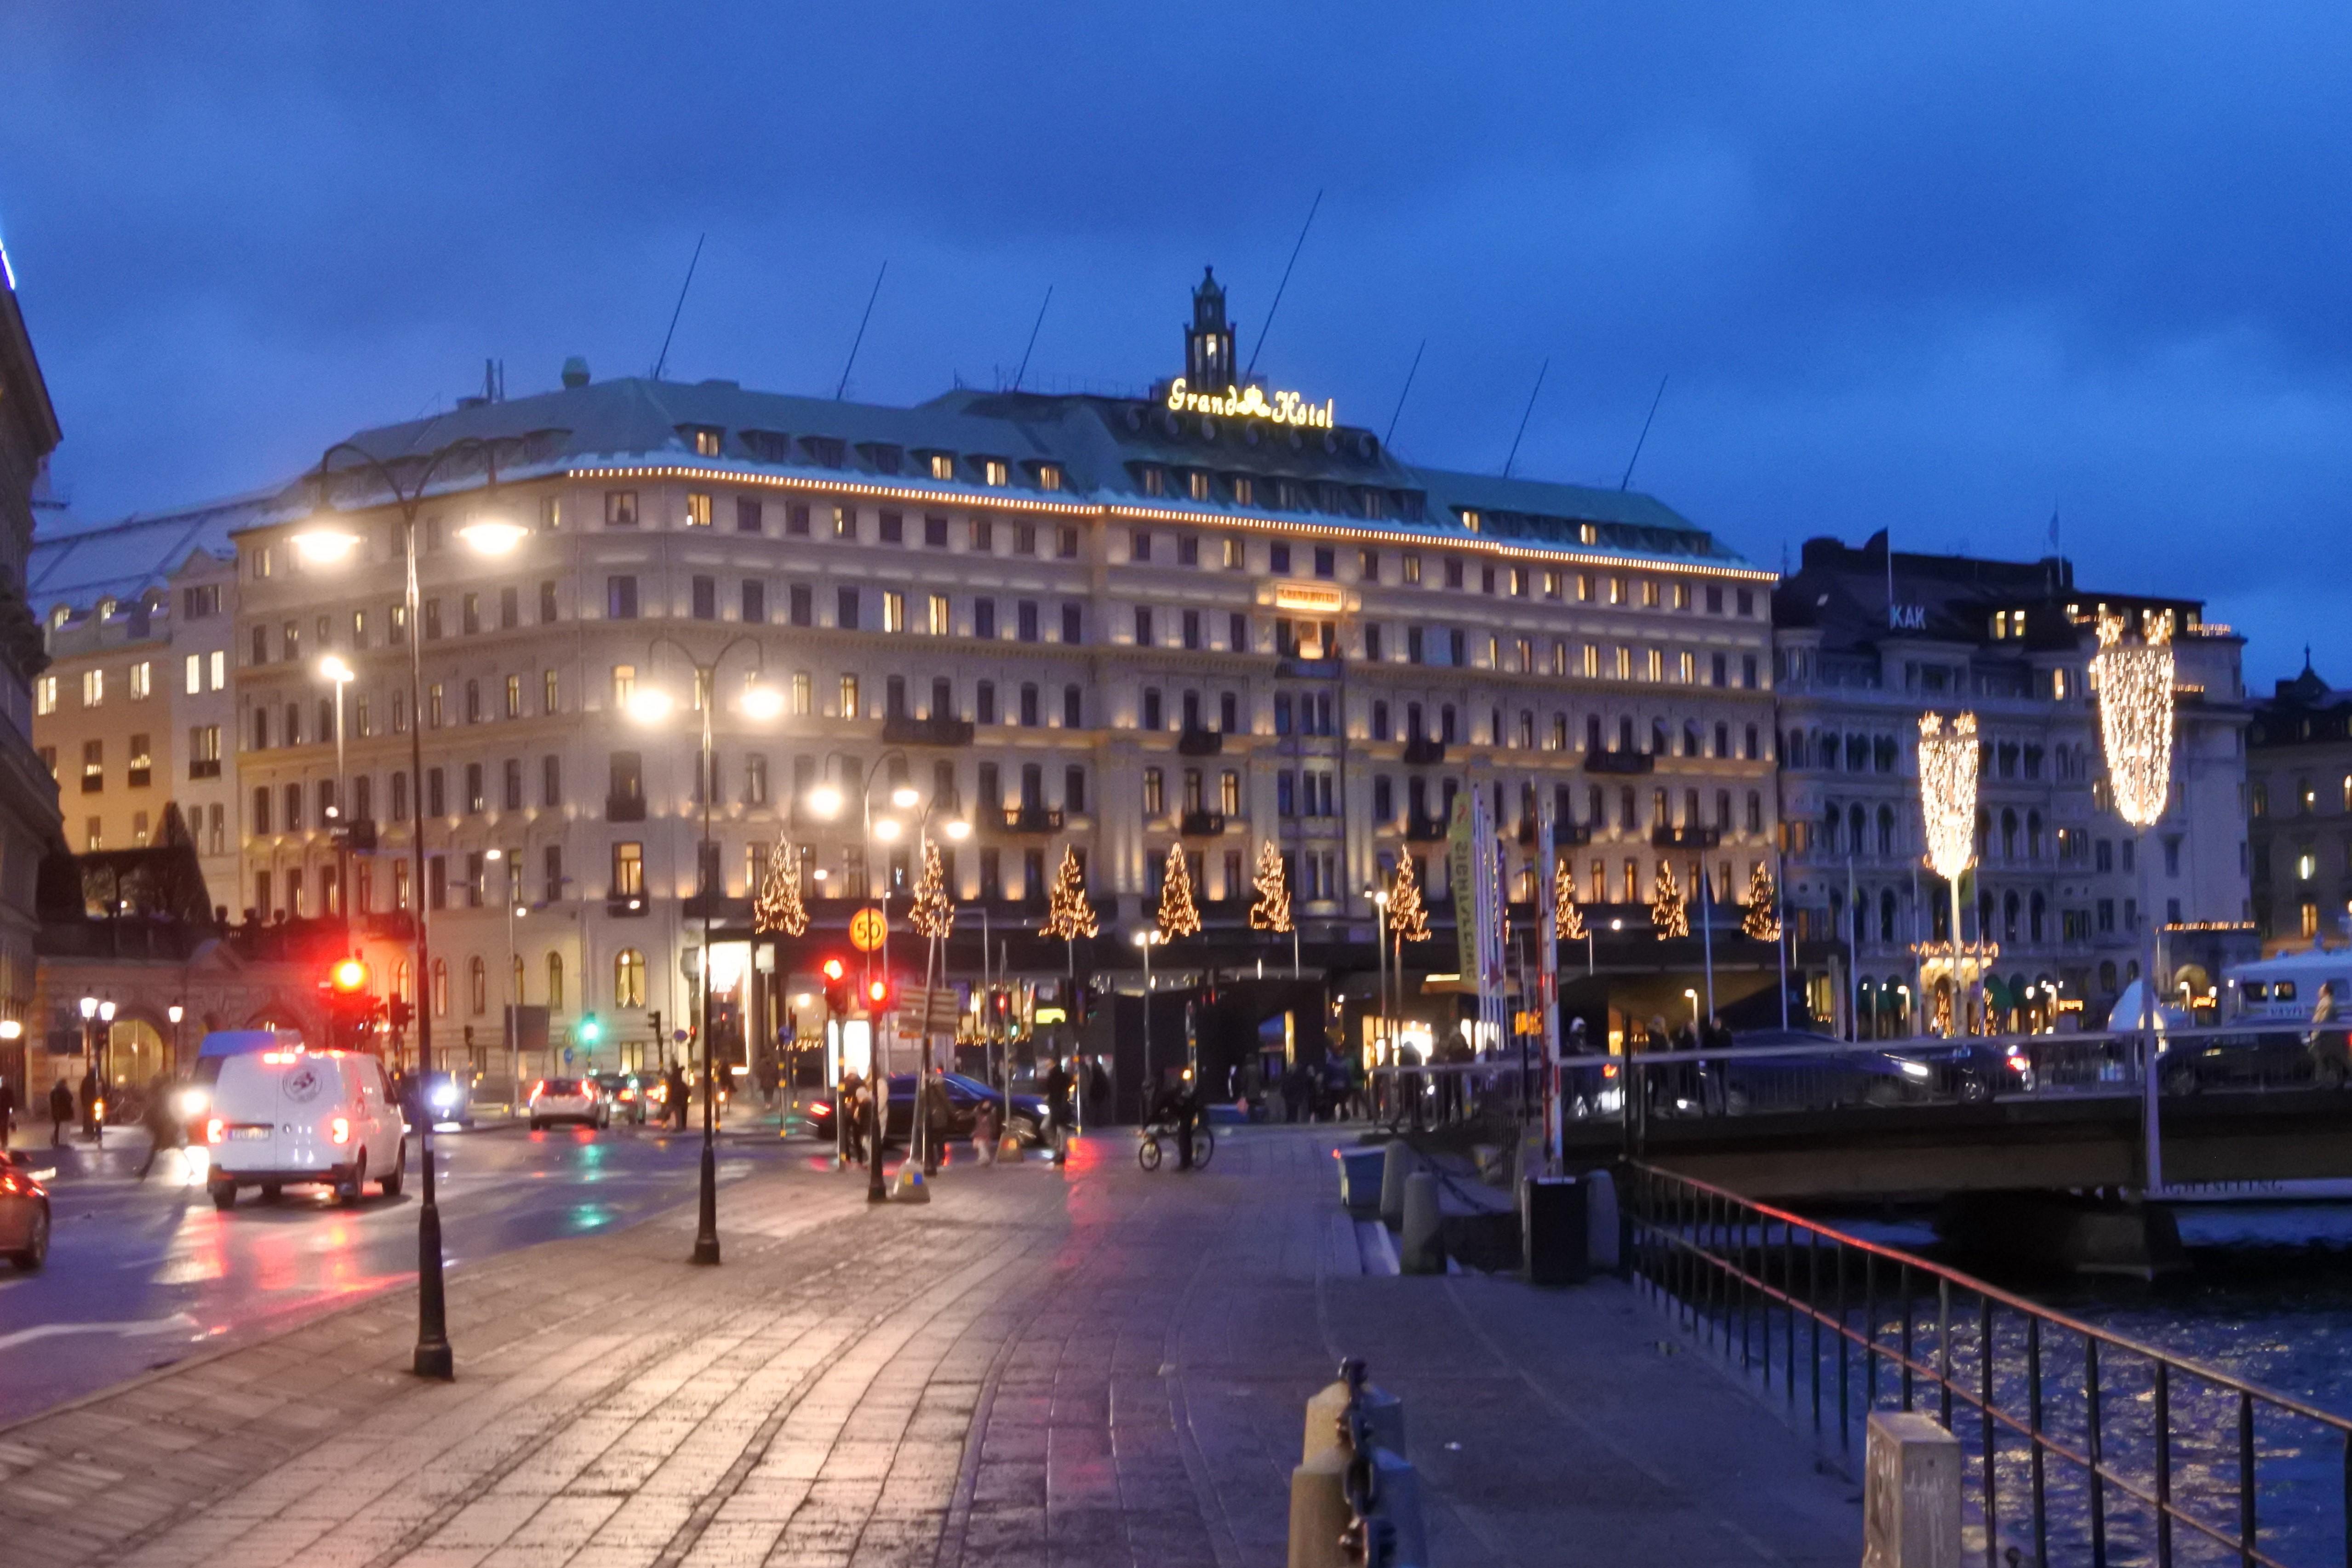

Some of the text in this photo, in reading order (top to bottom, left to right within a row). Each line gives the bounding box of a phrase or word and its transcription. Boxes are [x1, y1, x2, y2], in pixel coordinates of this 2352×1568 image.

[1168, 378, 1237, 416] Grand
[1890, 604, 1926, 630] KAK
[857, 922, 881, 939] 50
